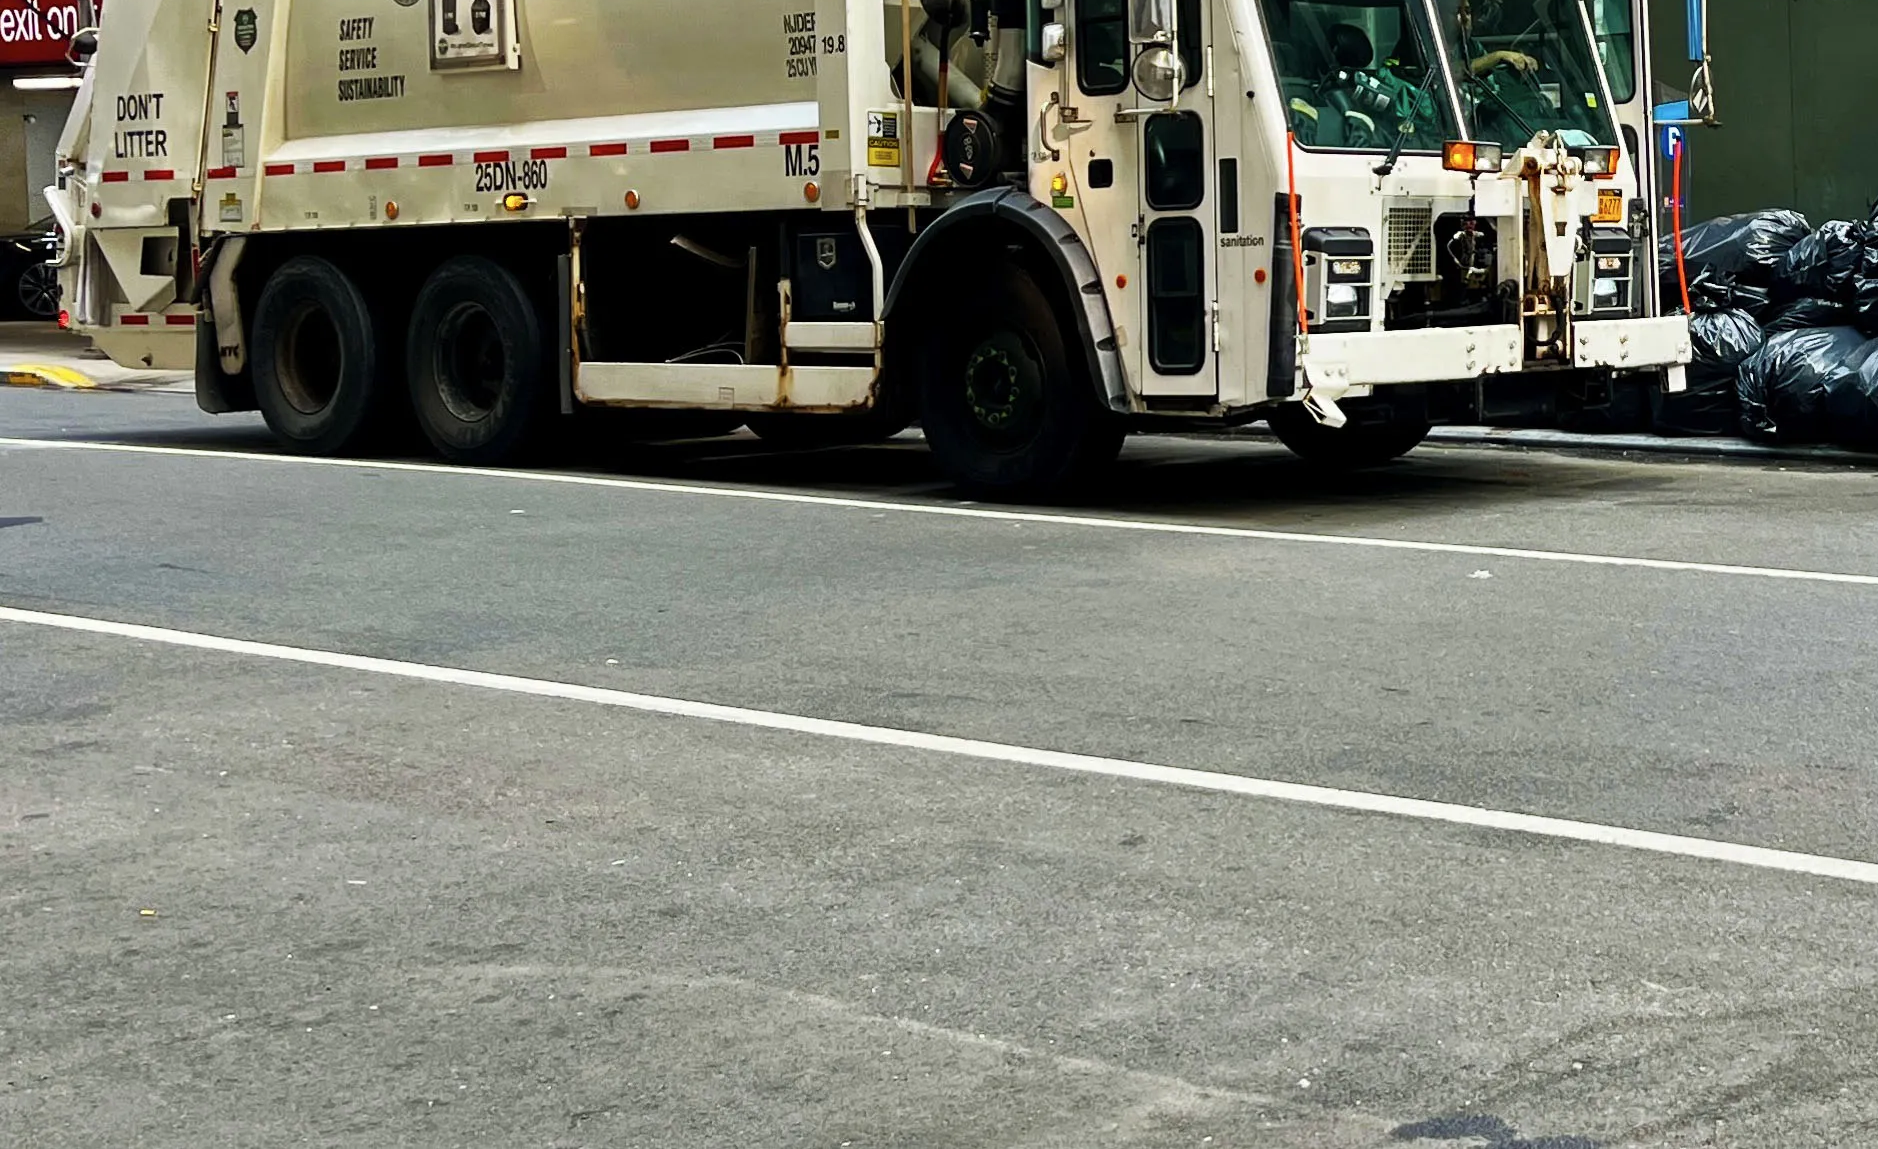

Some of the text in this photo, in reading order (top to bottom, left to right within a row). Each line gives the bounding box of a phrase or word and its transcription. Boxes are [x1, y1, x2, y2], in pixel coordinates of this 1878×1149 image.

[339, 16, 375, 41] SAFETY
[822, 35, 845, 55] 19.8
[339, 47, 377, 71] SERVICE
[338, 75, 405, 101] SUSTAINABILITY
[117, 93, 164, 122] DON'T
[114, 130, 168, 158] LITTER
[785, 144, 820, 177] M.5
[475, 160, 548, 192] 25DN-860
[1220, 234, 1264, 248] sanitation
